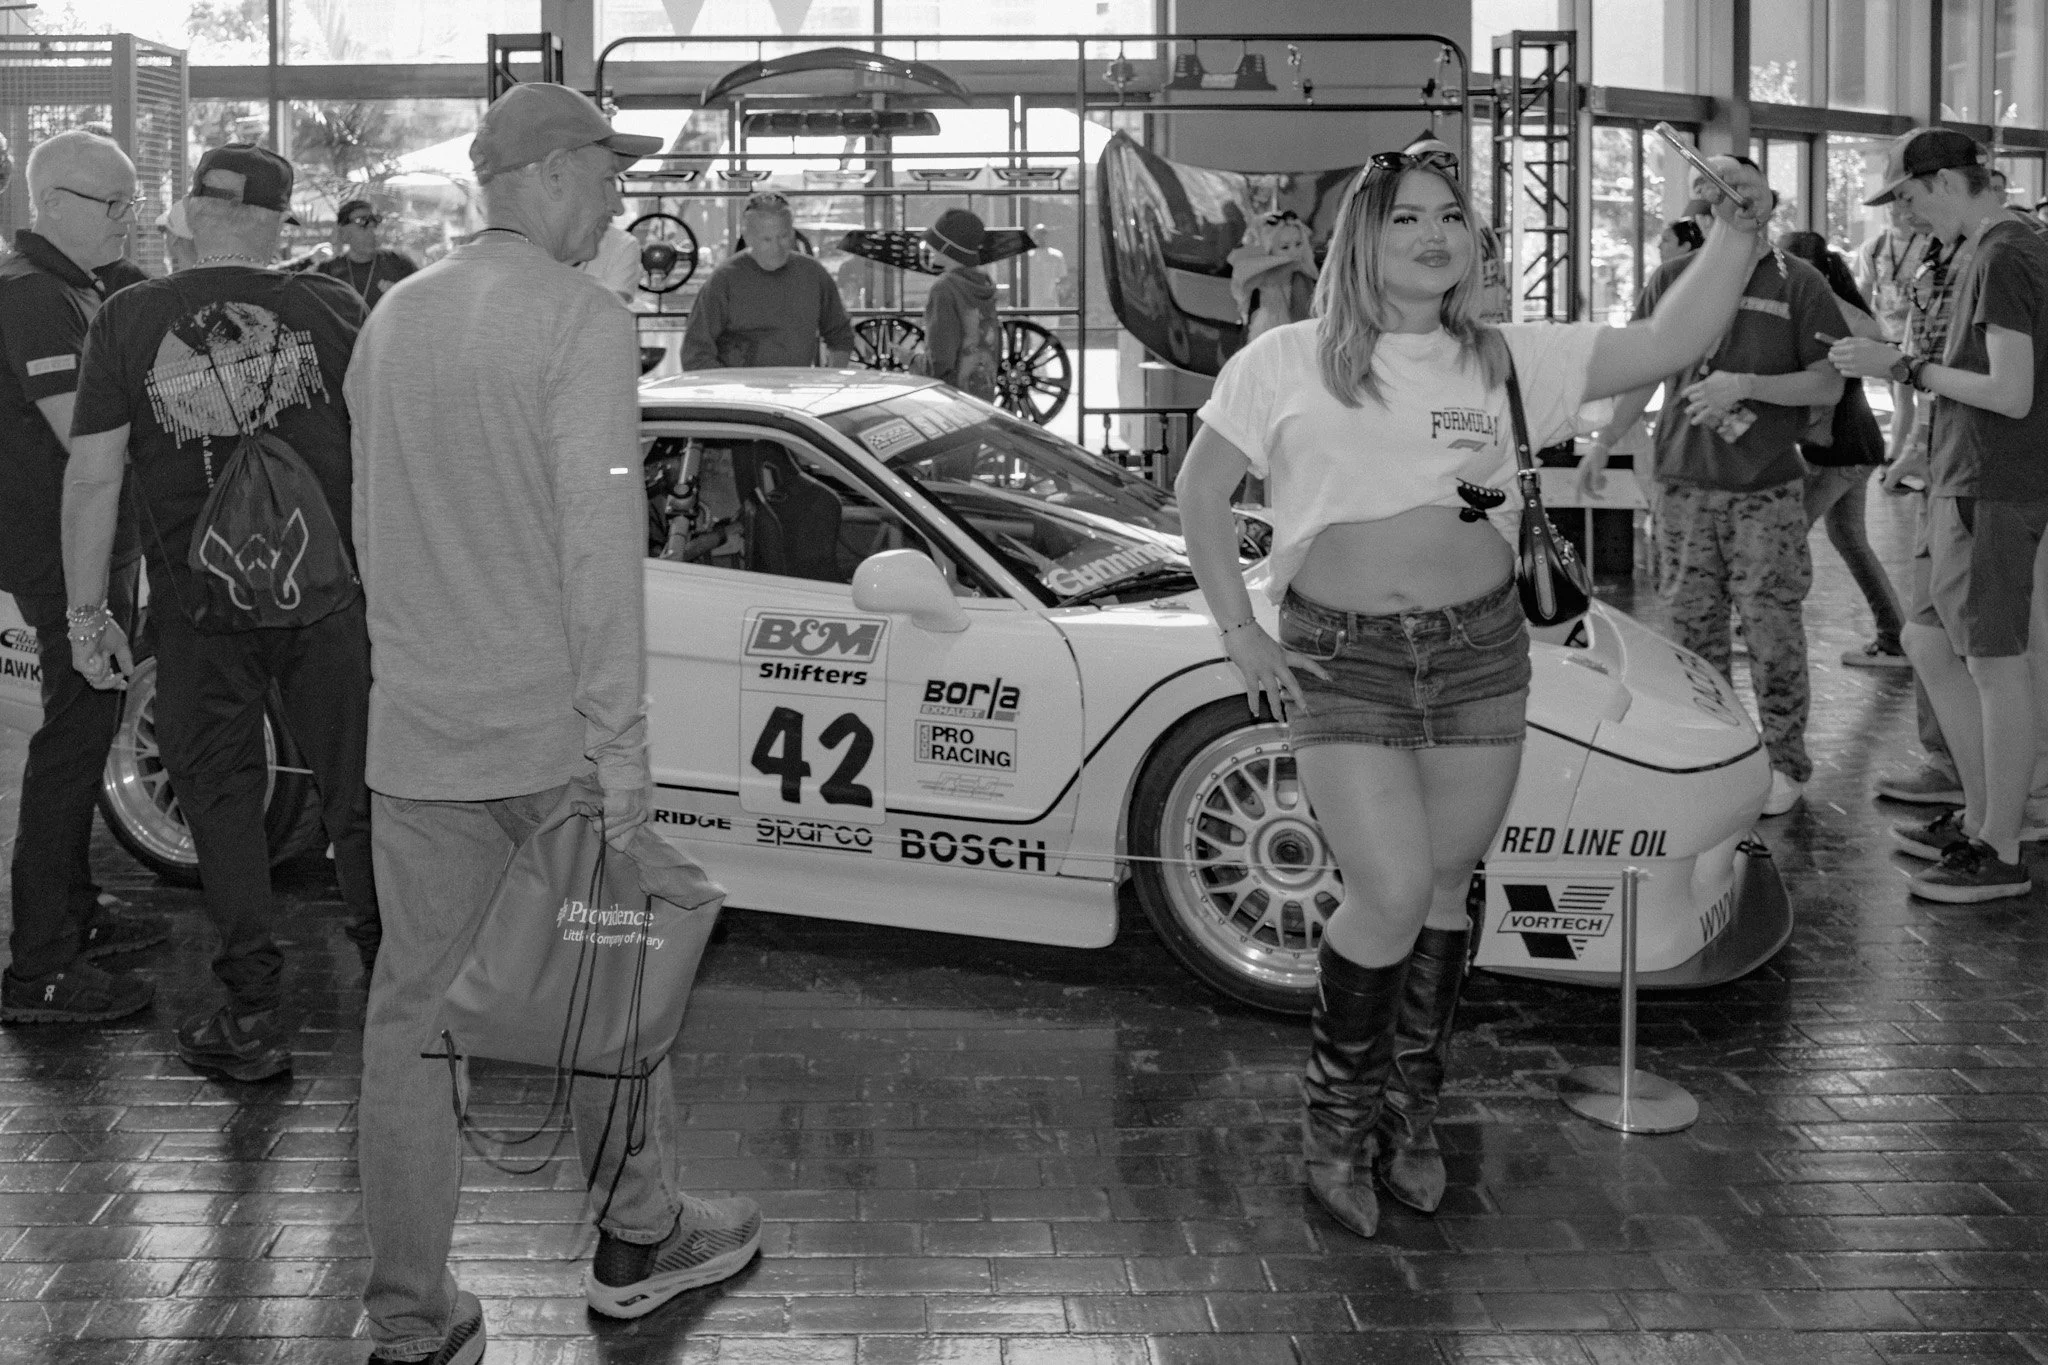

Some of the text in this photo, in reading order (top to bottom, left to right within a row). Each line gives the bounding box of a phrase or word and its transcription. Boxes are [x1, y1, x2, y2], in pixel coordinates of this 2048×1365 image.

[752, 618, 880, 656] B&M
[759, 662, 867, 685] Shifters
[932, 726, 974, 744] PRO
[751, 706, 874, 808] 42
[931, 744, 1011, 767] RACING
[757, 818, 873, 847] sparco
[1501, 826, 1667, 857] RED LINE OIL
[901, 828, 1046, 871] BOSCH
[567, 901, 655, 927] Providence
[1511, 916, 1602, 931] VORTECH
[624, 932, 636, 944] of
